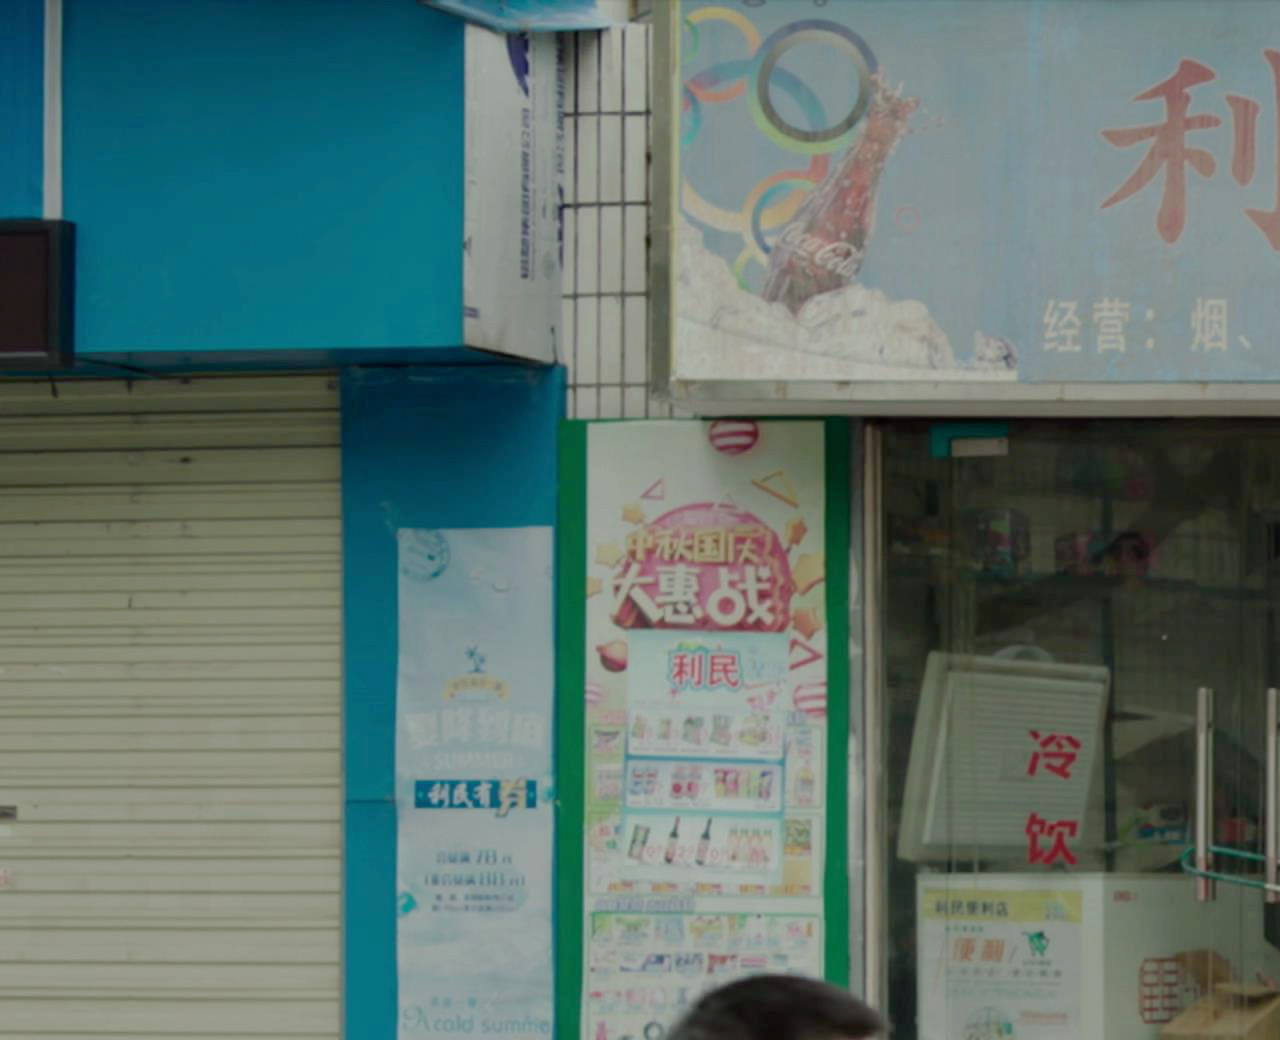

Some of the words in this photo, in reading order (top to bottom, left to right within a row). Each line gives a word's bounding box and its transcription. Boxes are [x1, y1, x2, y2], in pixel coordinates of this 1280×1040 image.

[672, 652, 740, 688] 利民
[1026, 730, 1082, 866] 冷饮
[434, 1016, 475, 1033] cold
